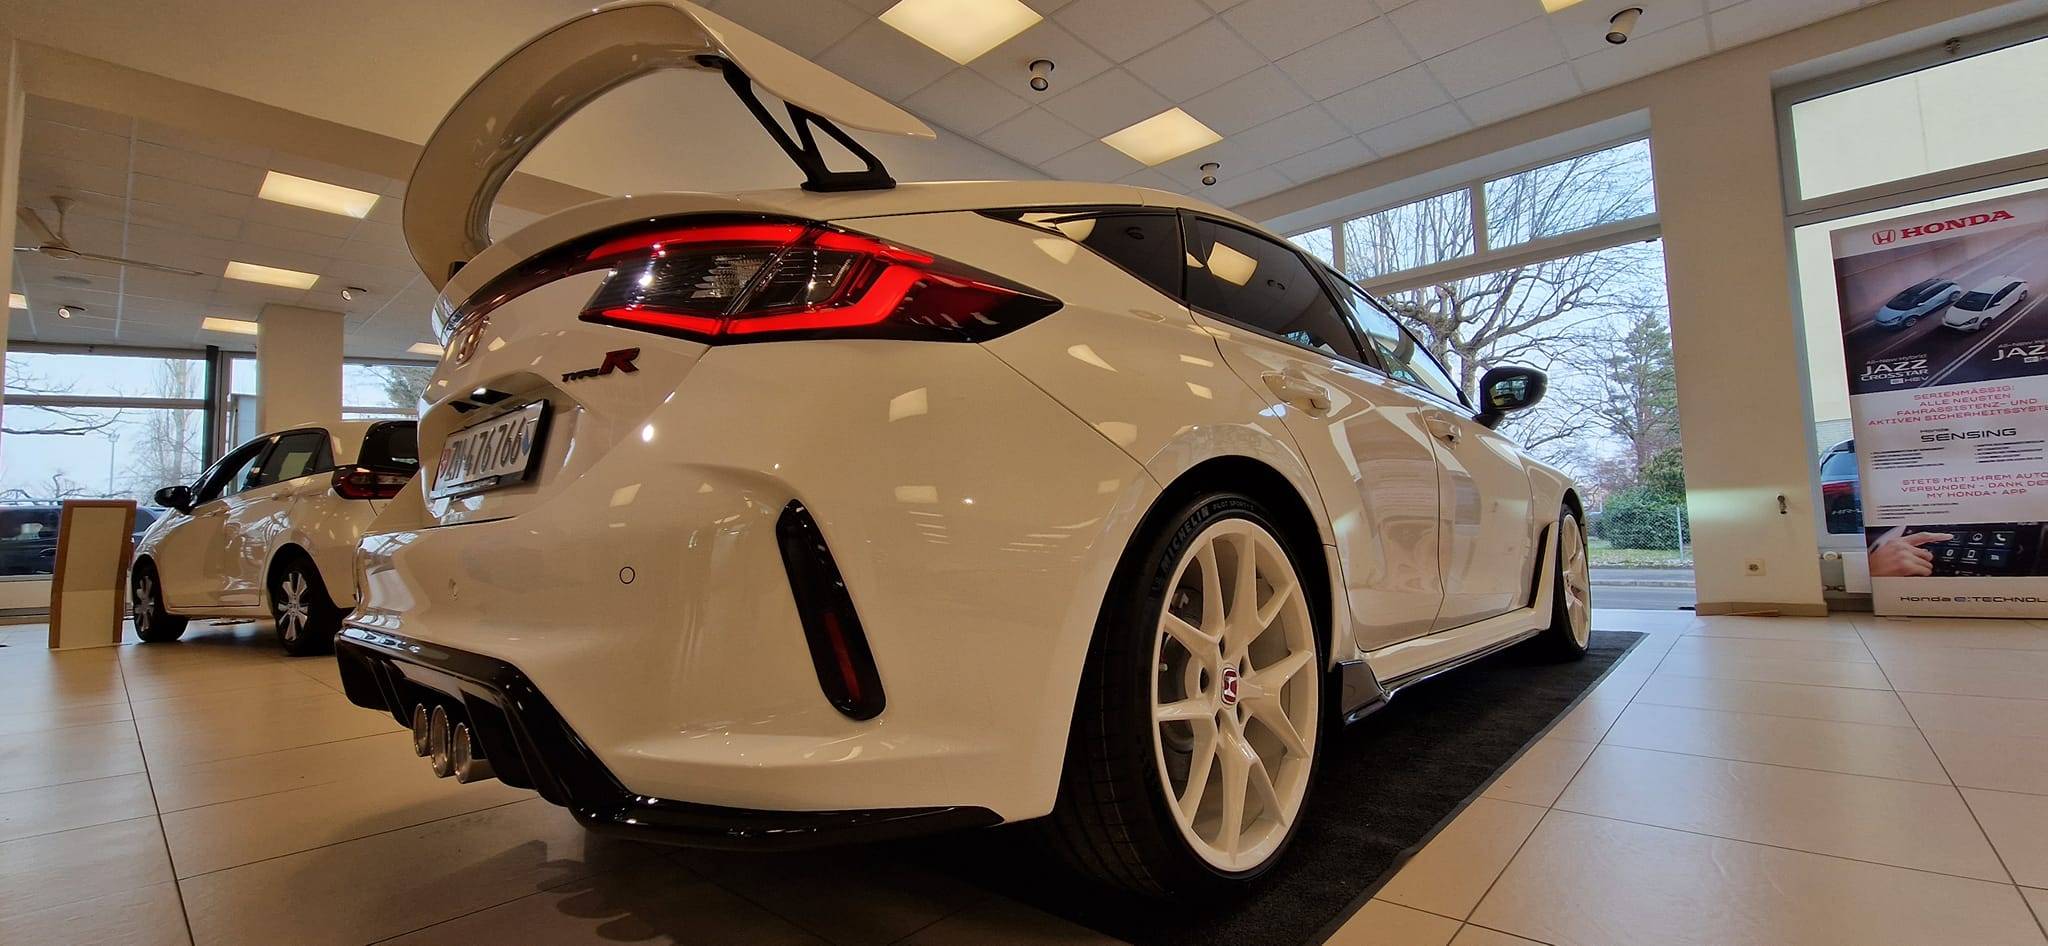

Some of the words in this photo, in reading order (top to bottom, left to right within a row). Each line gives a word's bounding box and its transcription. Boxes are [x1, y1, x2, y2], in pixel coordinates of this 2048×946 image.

[1901, 210, 2015, 239] HONDA
[600, 347, 640, 373] R
[1861, 359, 1928, 376] JAZZ
[1860, 369, 1929, 381] CROSSTAR
[1897, 401, 2007, 416] FAHRASSISTENZ-
[2010, 398, 2037, 406] UND
[1920, 399, 1950, 407] ALLE
[1953, 393, 2011, 404] NEUSTEN
[1868, 416, 1921, 426] AKTIVEN
[1921, 428, 2017, 443] SENSING
[1901, 483, 1975, 492] VERBUNDEN
[1989, 481, 2023, 489] DANK
[1903, 478, 1940, 486] STETS
[1970, 474, 2012, 482] IHREM
[1160, 505, 1210, 572] MICHELIN
